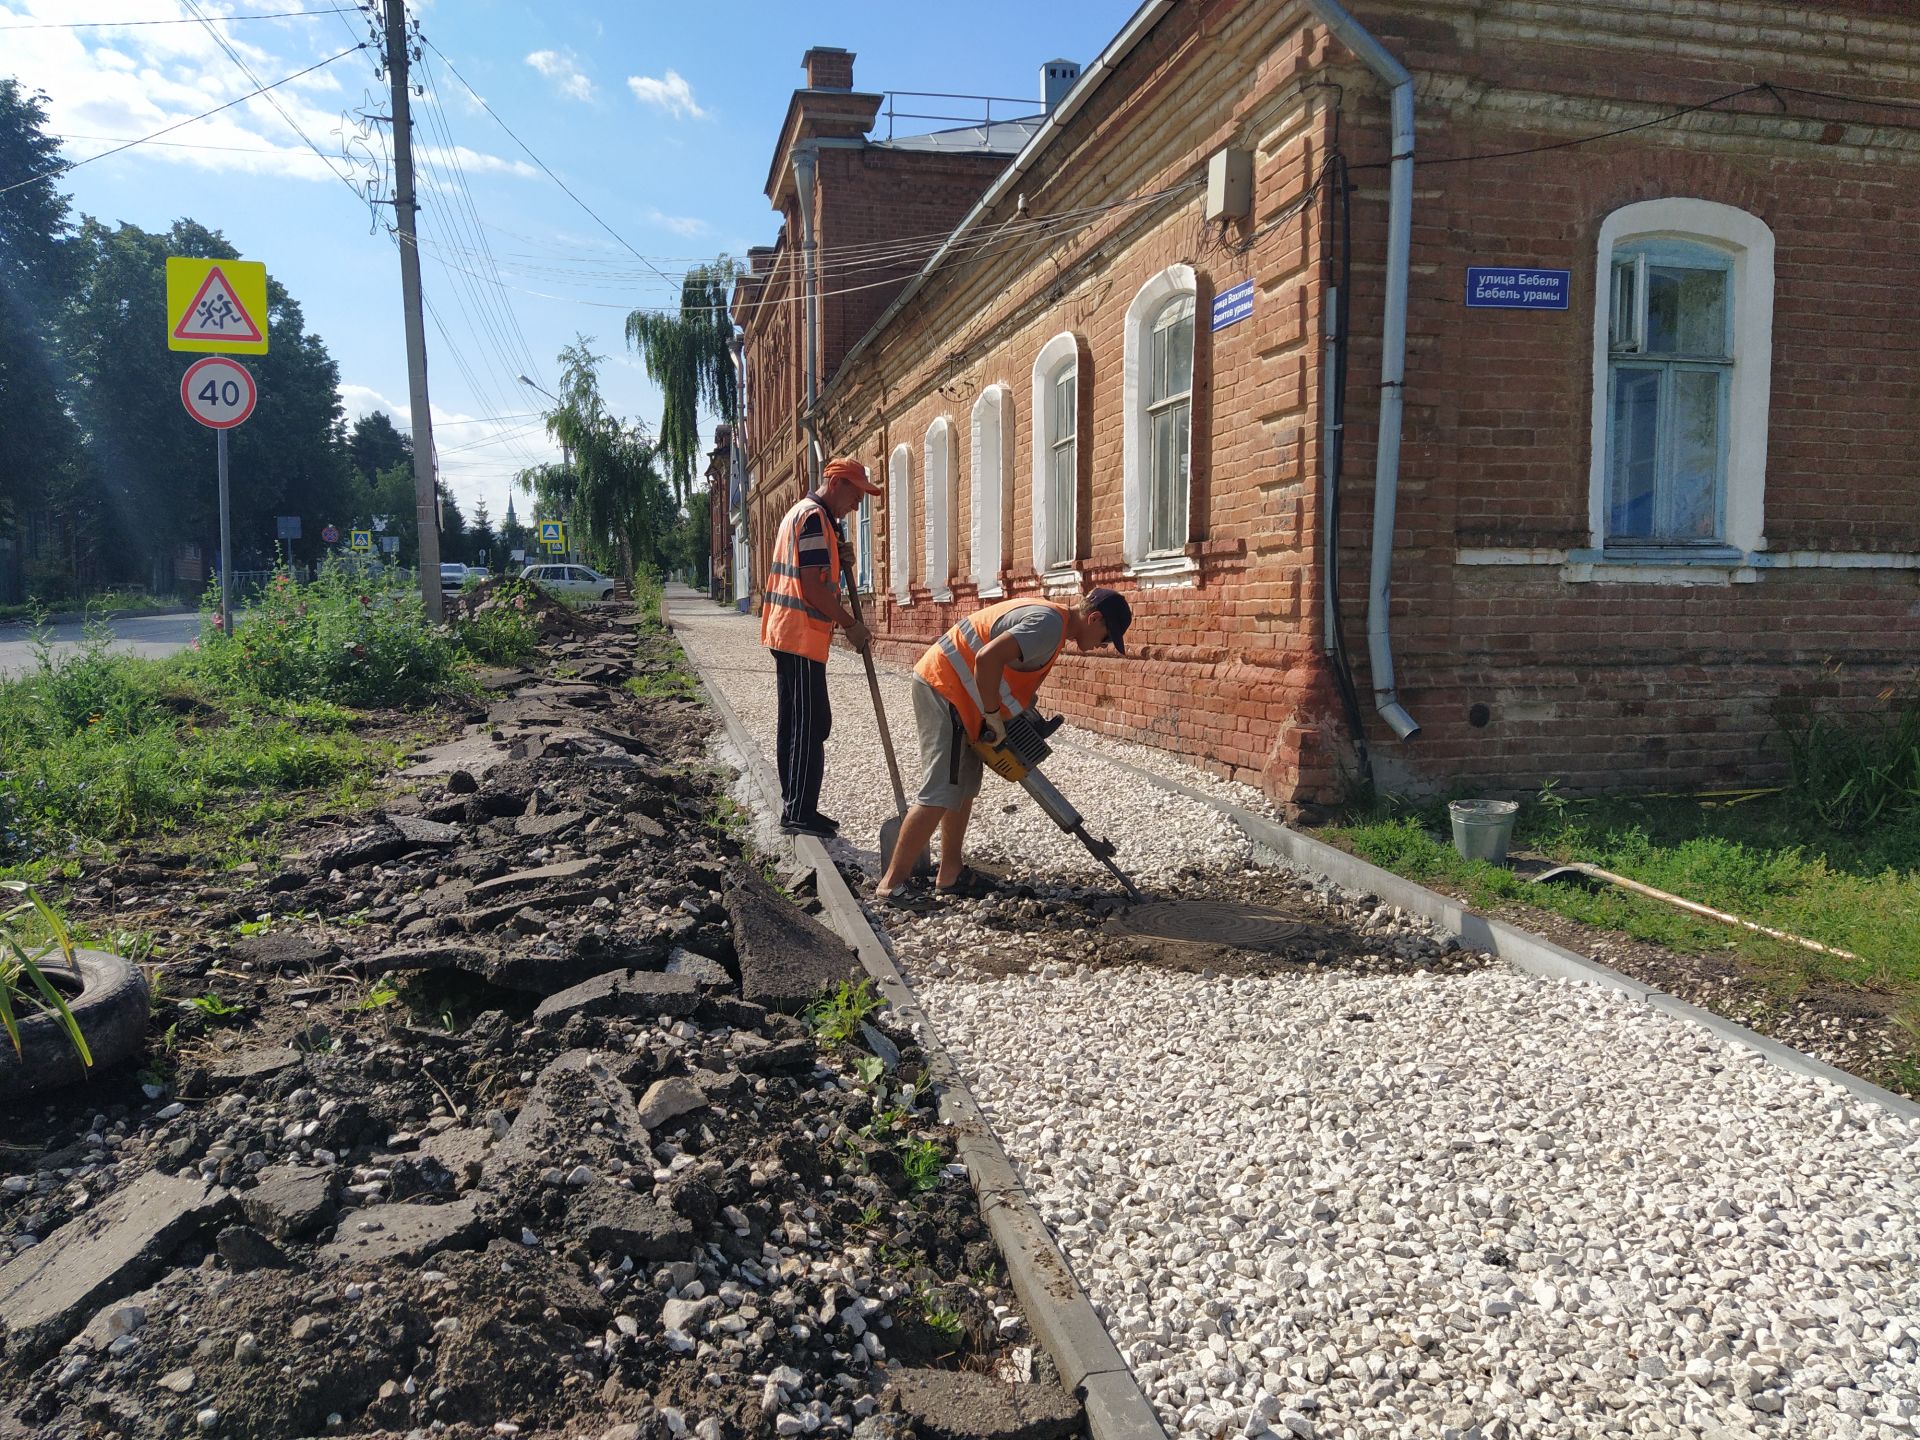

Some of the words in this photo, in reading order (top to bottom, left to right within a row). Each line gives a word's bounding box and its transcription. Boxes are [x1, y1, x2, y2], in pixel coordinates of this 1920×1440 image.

[1479, 275, 1515, 287] улица
[1518, 274, 1560, 287] Бебеля
[1228, 286, 1254, 304] Вахитова
[1475, 287, 1521, 299] Бебель
[1523, 290, 1560, 302] урамы
[1234, 299, 1253, 317] урамы
[198, 379, 240, 406] 40
